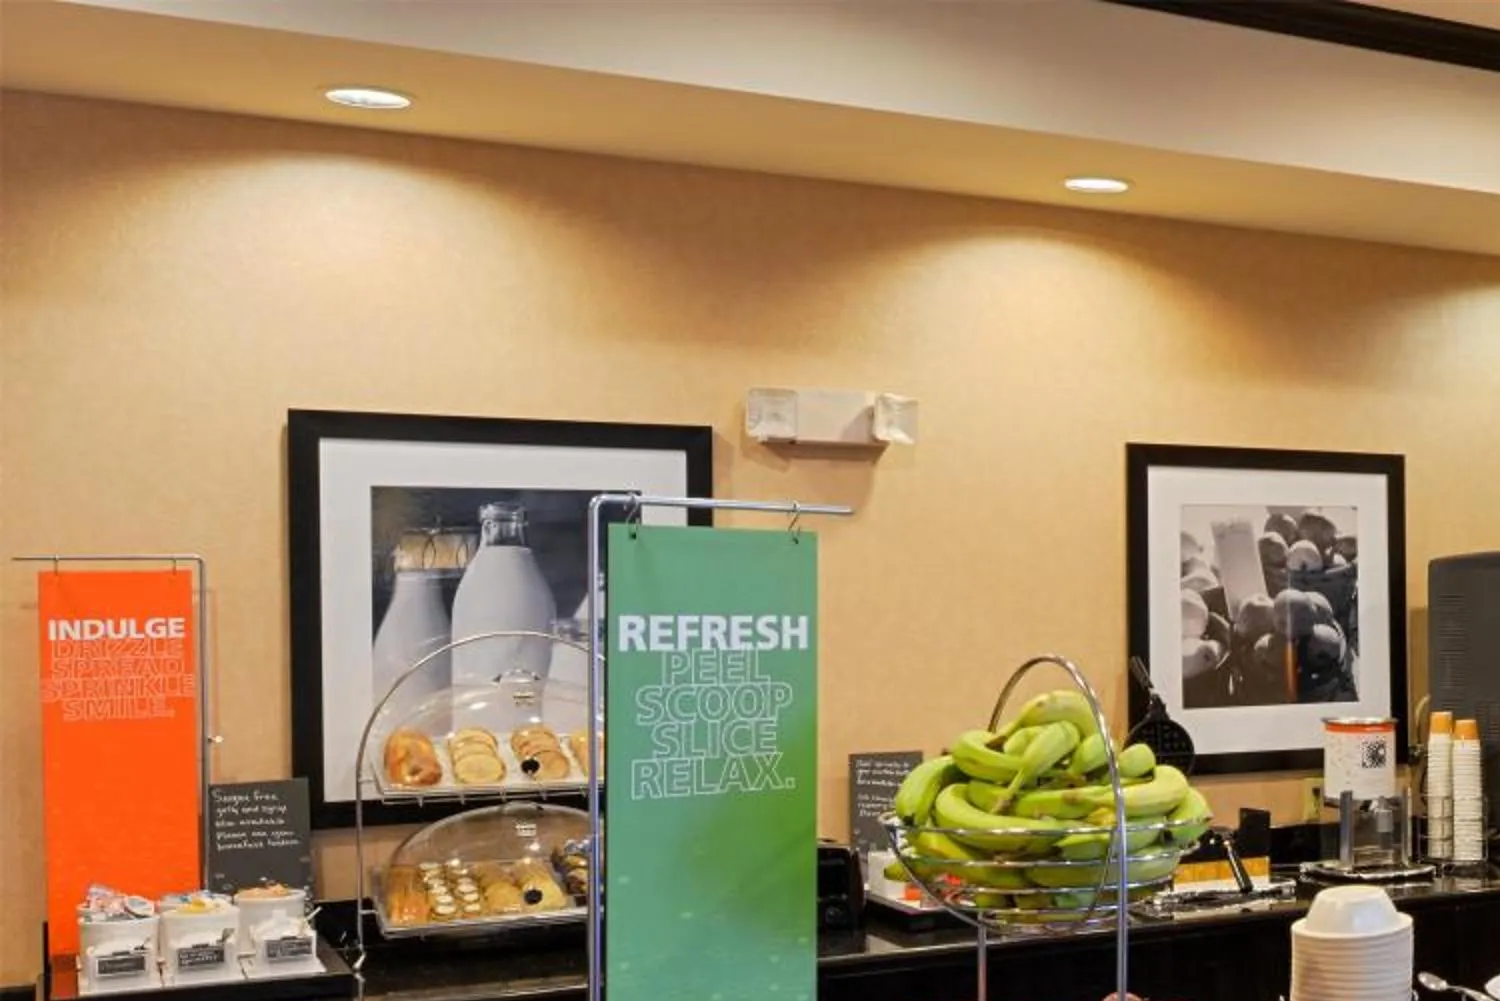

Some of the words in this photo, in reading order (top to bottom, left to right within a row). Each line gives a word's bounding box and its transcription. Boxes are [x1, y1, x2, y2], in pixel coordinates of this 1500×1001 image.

[47, 617, 186, 641] INDULGE
[618, 615, 809, 652] REFRESH
[52, 639, 185, 659] DRIZZLE
[662, 648, 771, 686] PEEL
[51, 657, 186, 680] SPREAD
[41, 674, 196, 703] SPRINKLE
[635, 682, 793, 726] SCOOP
[651, 719, 777, 759] SLICE
[631, 752, 796, 800] RELAX.
